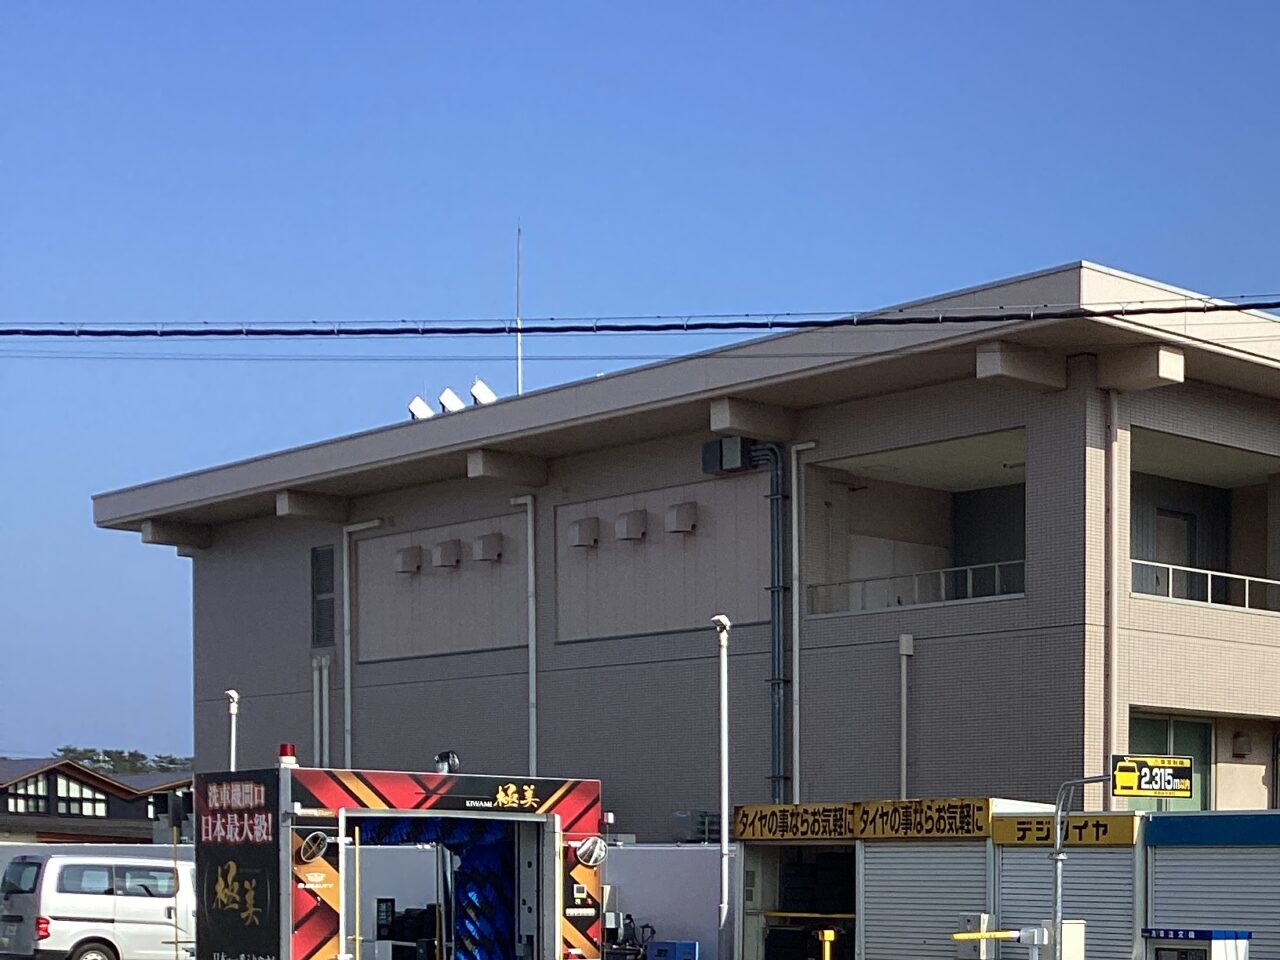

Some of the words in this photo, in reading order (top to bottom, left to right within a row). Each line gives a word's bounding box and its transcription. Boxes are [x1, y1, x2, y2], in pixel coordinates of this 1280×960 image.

[201, 813, 272, 841] 日本最大級!
[860, 803, 983, 835] タイヤの事ならお気軽に
